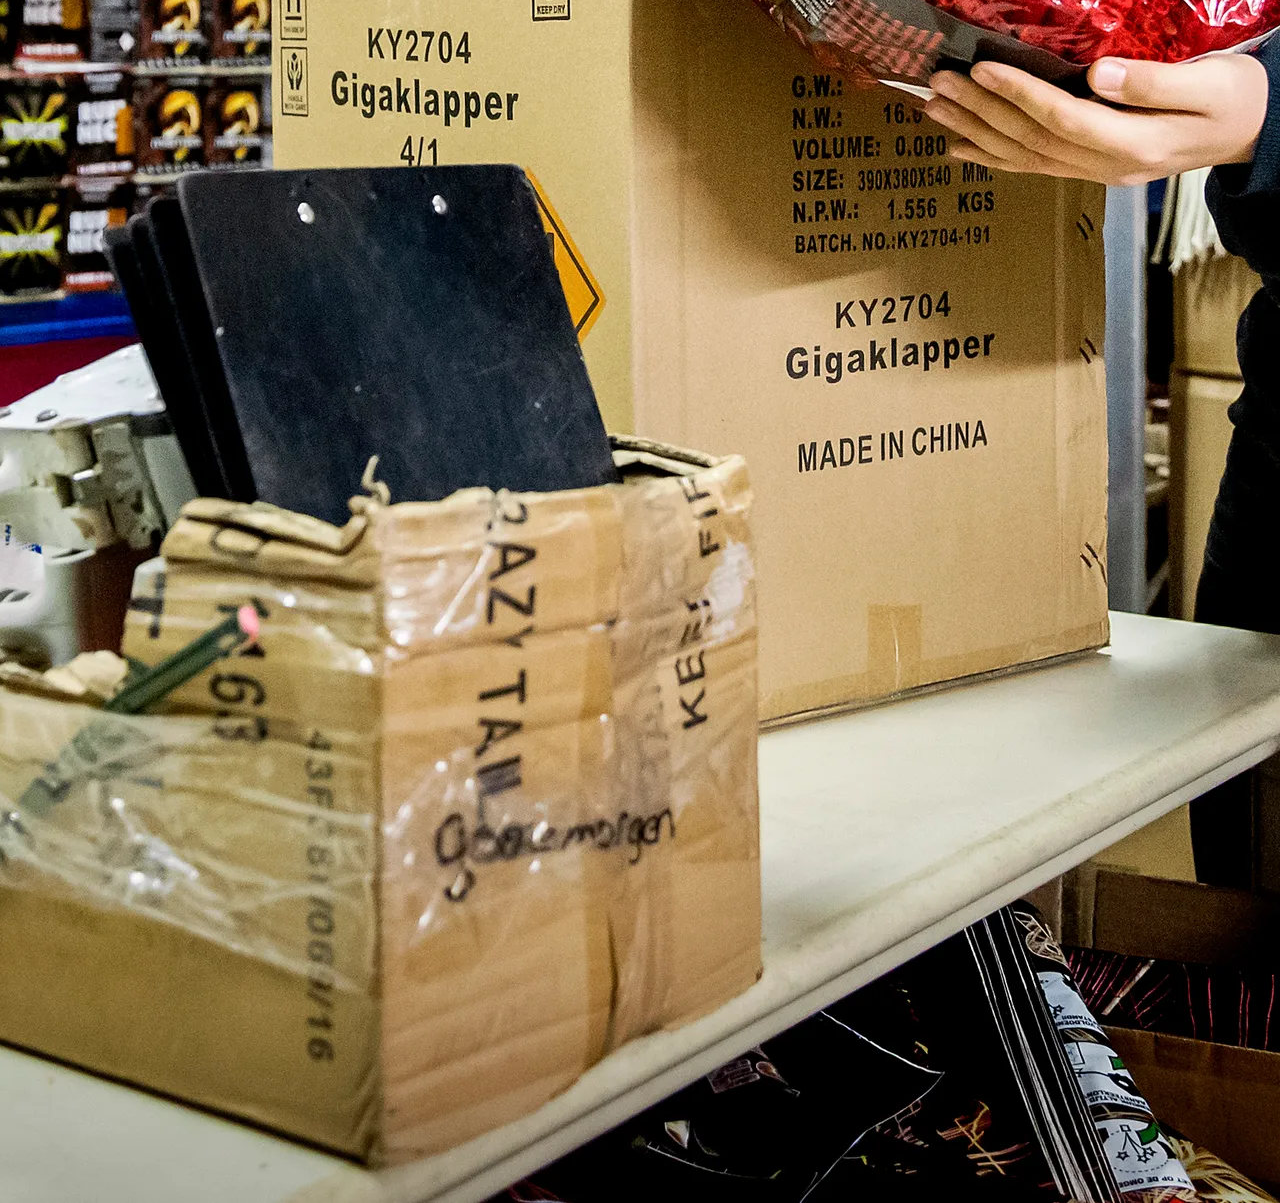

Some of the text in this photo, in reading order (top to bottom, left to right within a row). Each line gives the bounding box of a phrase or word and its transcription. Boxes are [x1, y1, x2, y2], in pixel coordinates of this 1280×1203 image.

[536, 4, 566, 15] KEEP DRY
[367, 27, 472, 64] KY2704
[331, 70, 519, 128] Gigaklapper
[792, 75, 843, 98] G.W.:
[792, 108, 843, 129] N.W.:
[400, 137, 440, 167] 4/1
[793, 134, 946, 161] VOLUME: 0.080
[793, 170, 844, 191] SIZE:
[858, 166, 951, 192] 390X380X540
[793, 191, 995, 223] N.P.W.: 1.556 KGS
[794, 233, 857, 253] BATCH.
[835, 290, 951, 328] KY2704
[786, 331, 995, 383] Gigaklapper
[798, 419, 988, 473] MADE IN CHINA
